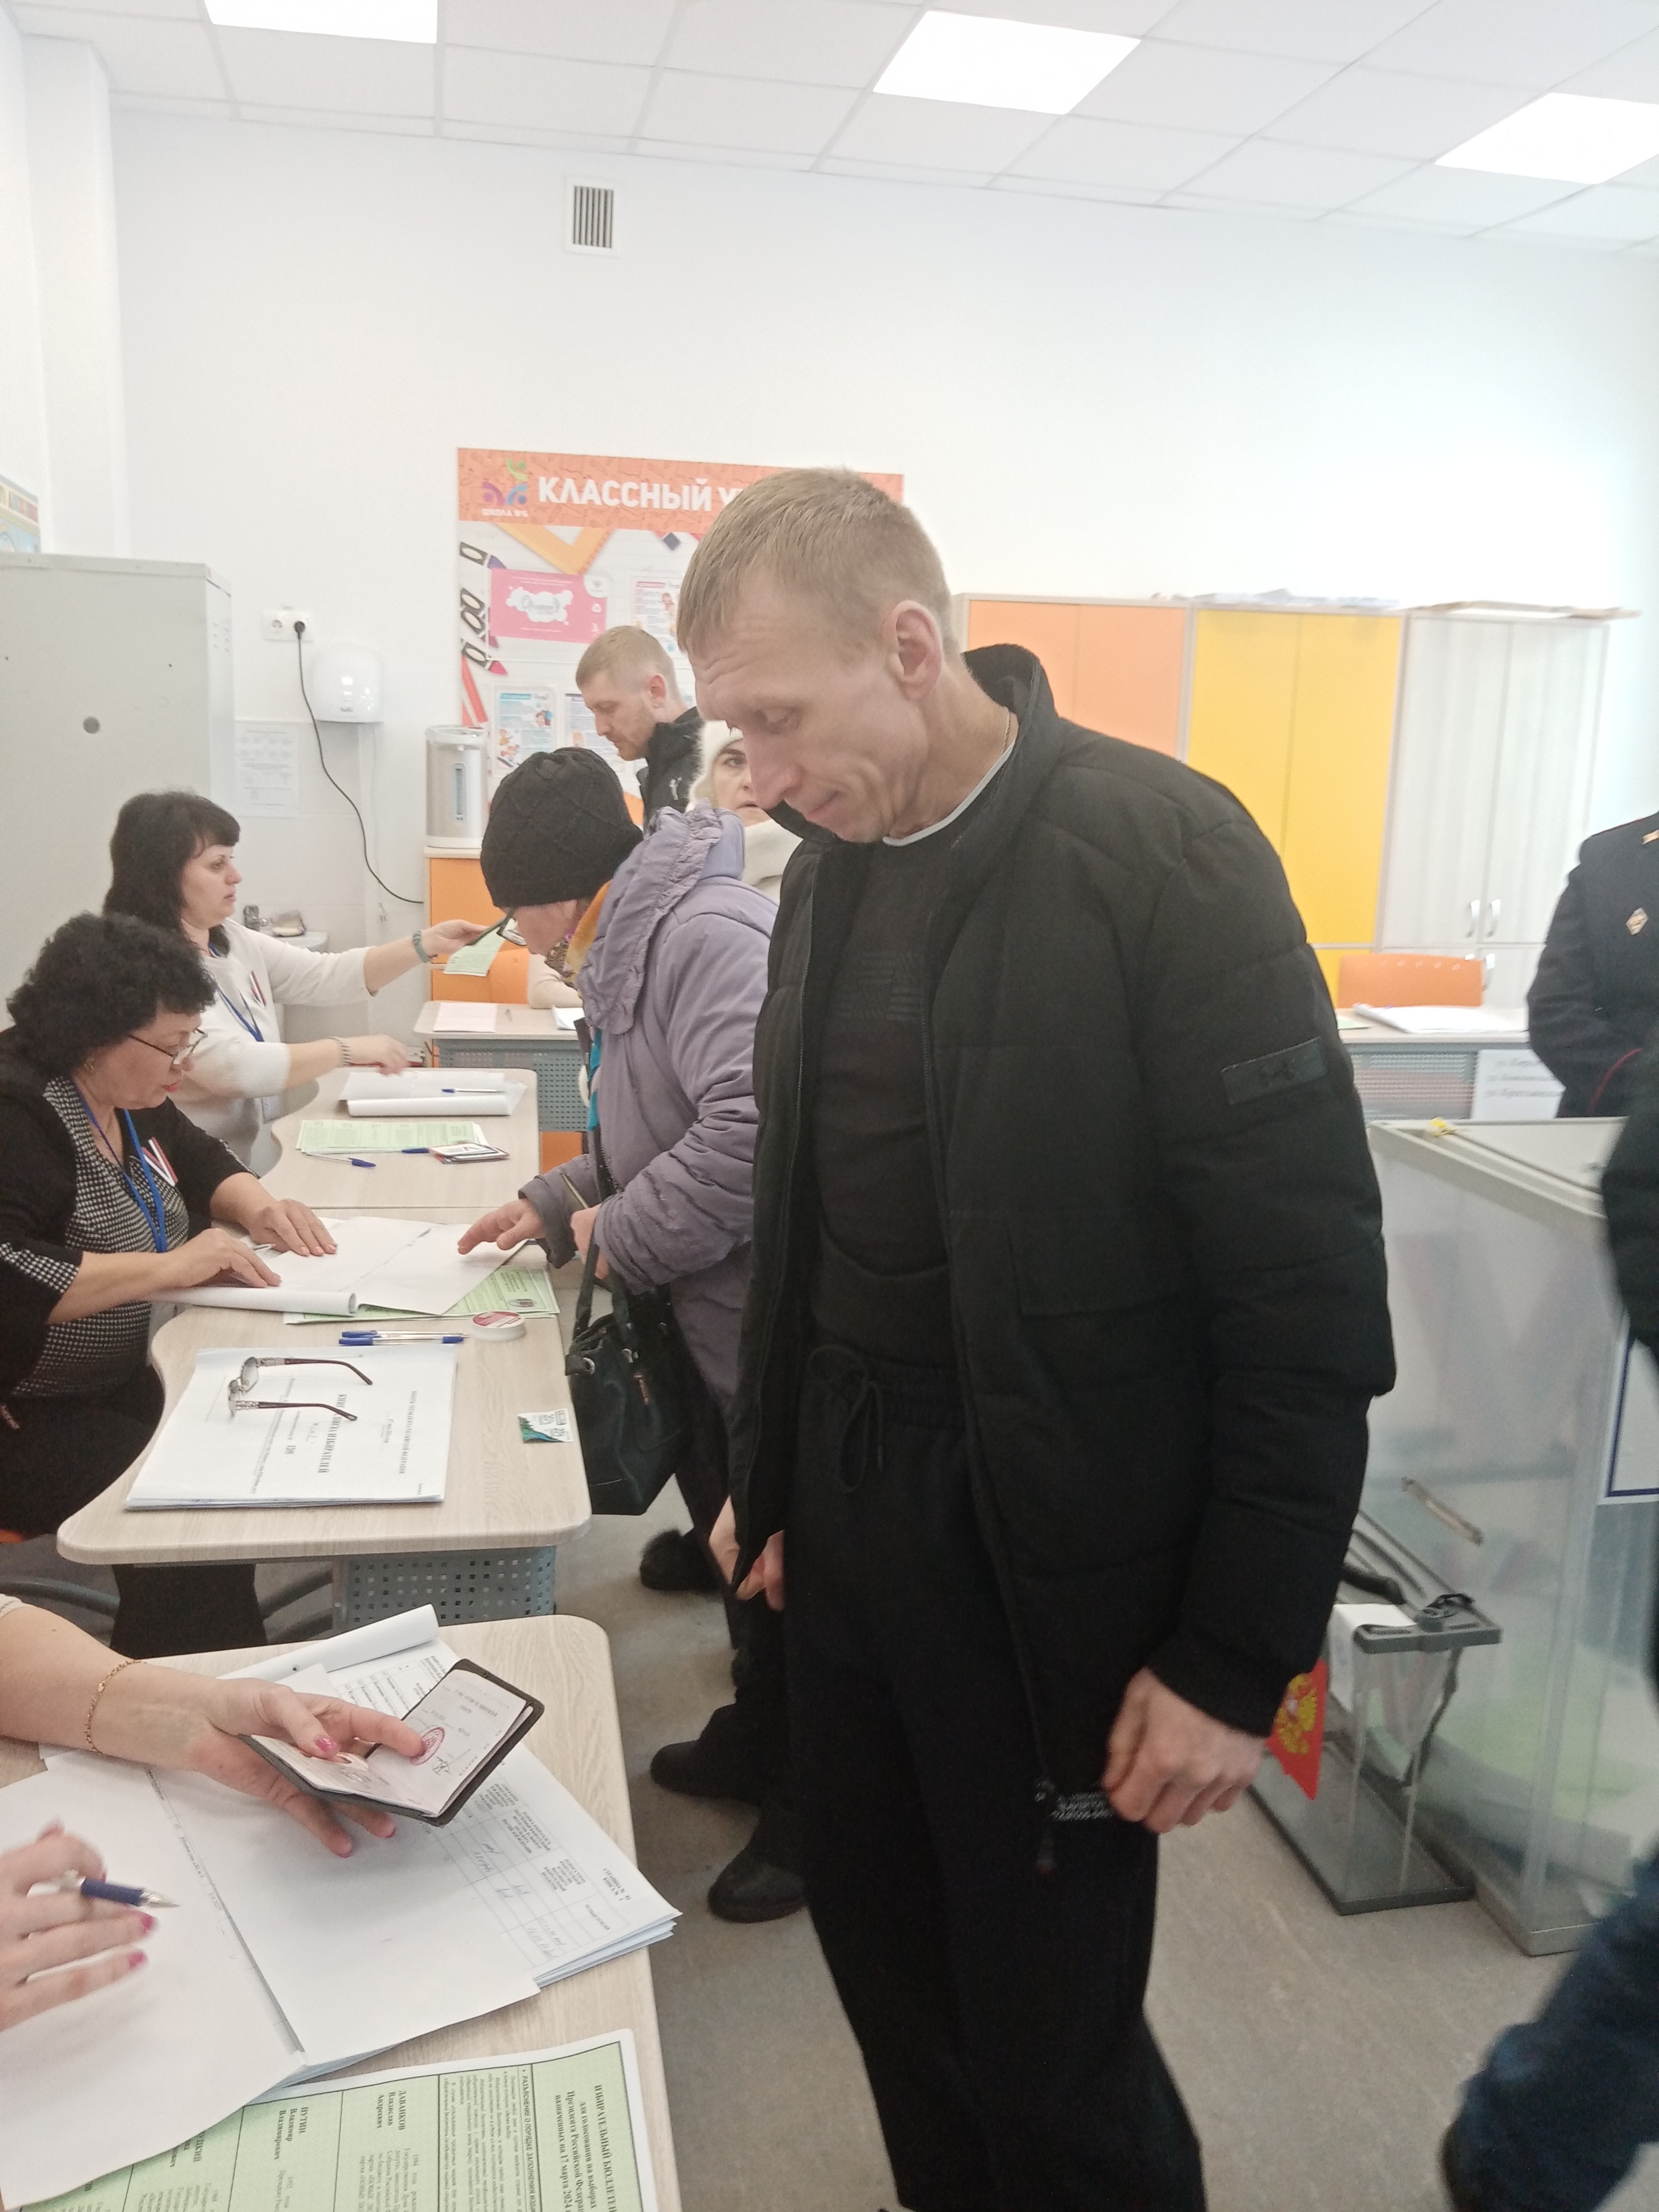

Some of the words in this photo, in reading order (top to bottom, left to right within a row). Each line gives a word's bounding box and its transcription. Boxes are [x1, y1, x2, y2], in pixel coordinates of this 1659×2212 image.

[538, 476, 711, 512] КЛАССНЫЙ
[336, 1394, 347, 1408] КНИГ
[317, 1433, 337, 1473] ИЗБИРАТЕЛЕЙ
[376, 2094, 384, 2129] Андреевич
[522, 2075, 531, 2117] РАЗЪЯСНЕНИЕ
[274, 2110, 286, 2160] Владимирович
[285, 2108, 297, 2141] Владимир
[299, 2107, 308, 2133] ПУТИН
[555, 2094, 565, 2142] назначенных
[565, 2091, 576, 2133] Президента
[571, 2133, 583, 2179] Российской
[594, 2084, 613, 2159] ИЗБИРАТЕЛЬНЫЙ
[559, 2143, 566, 2153] на
[581, 2115, 592, 2163] голосования
[526, 2151, 535, 2194] ЗАПОЛНЕНИЯ
[559, 2164, 569, 2189] марта
[560, 2155, 569, 2163] 17
[586, 2163, 593, 2173] на
[563, 2190, 573, 2209] 2024
[587, 2175, 598, 2209] выборах
